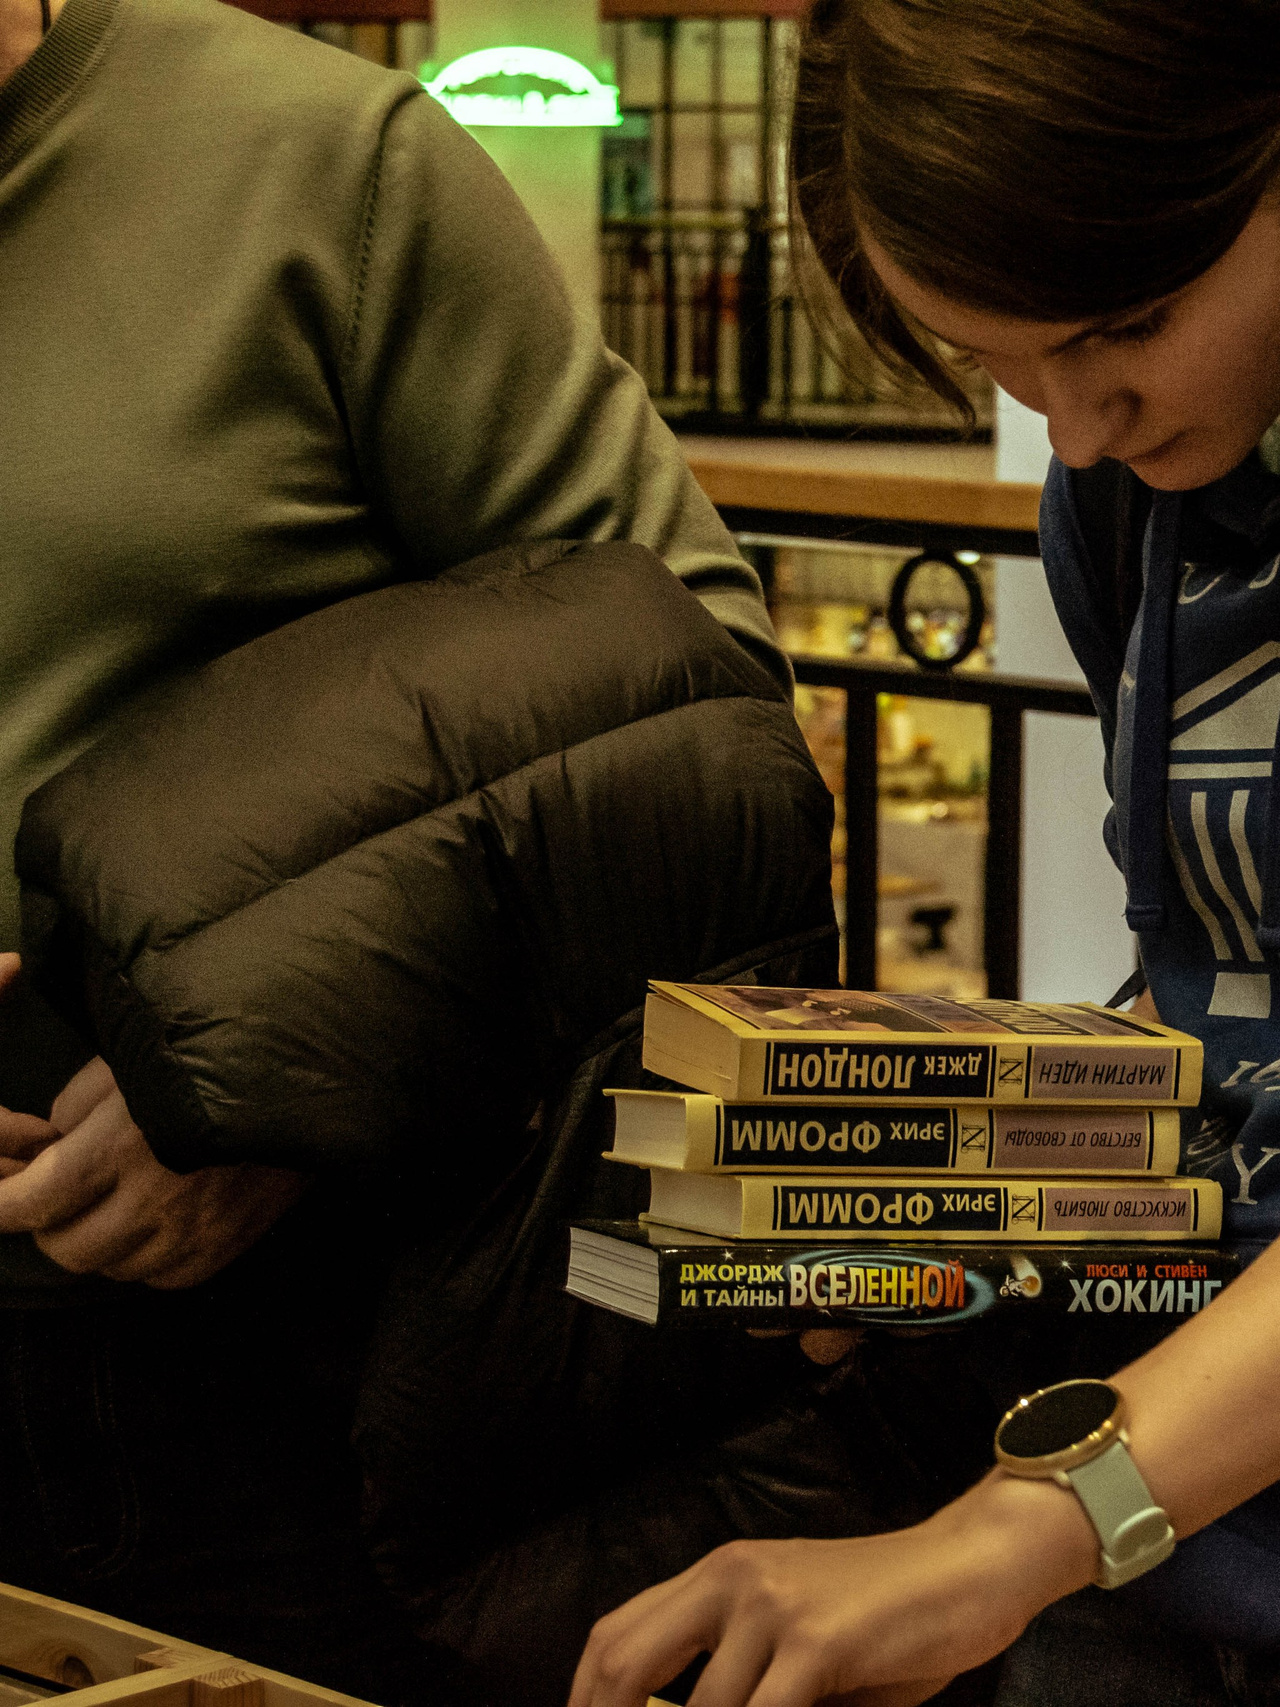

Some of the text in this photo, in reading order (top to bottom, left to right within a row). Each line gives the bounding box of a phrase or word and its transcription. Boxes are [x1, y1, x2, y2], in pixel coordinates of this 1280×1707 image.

[778, 1047, 983, 1088] ДЖЕК ЛОНДОН
[1039, 1062, 1167, 1085] МАРТИН ИДЕН
[732, 1120, 945, 1153] ЭРИХ ФРОММ
[1004, 1130, 1142, 1148] БЕГСТВО ОТ СВОБОДЫ
[788, 1192, 996, 1225] ЭРИХ ФРОММ
[1054, 1200, 1186, 1217] ИСКУССТВО ЛЮБИТЬ
[679, 1263, 785, 1284] ДЖОРДЖ
[1086, 1264, 1207, 1278] ЛЮСИ И СТИВЕН
[789, 1260, 966, 1308] ВСЕЛЕННОЙ
[680, 1286, 784, 1307] И ТАЙНЫ
[1067, 1279, 1222, 1313] ХОКИНГ
